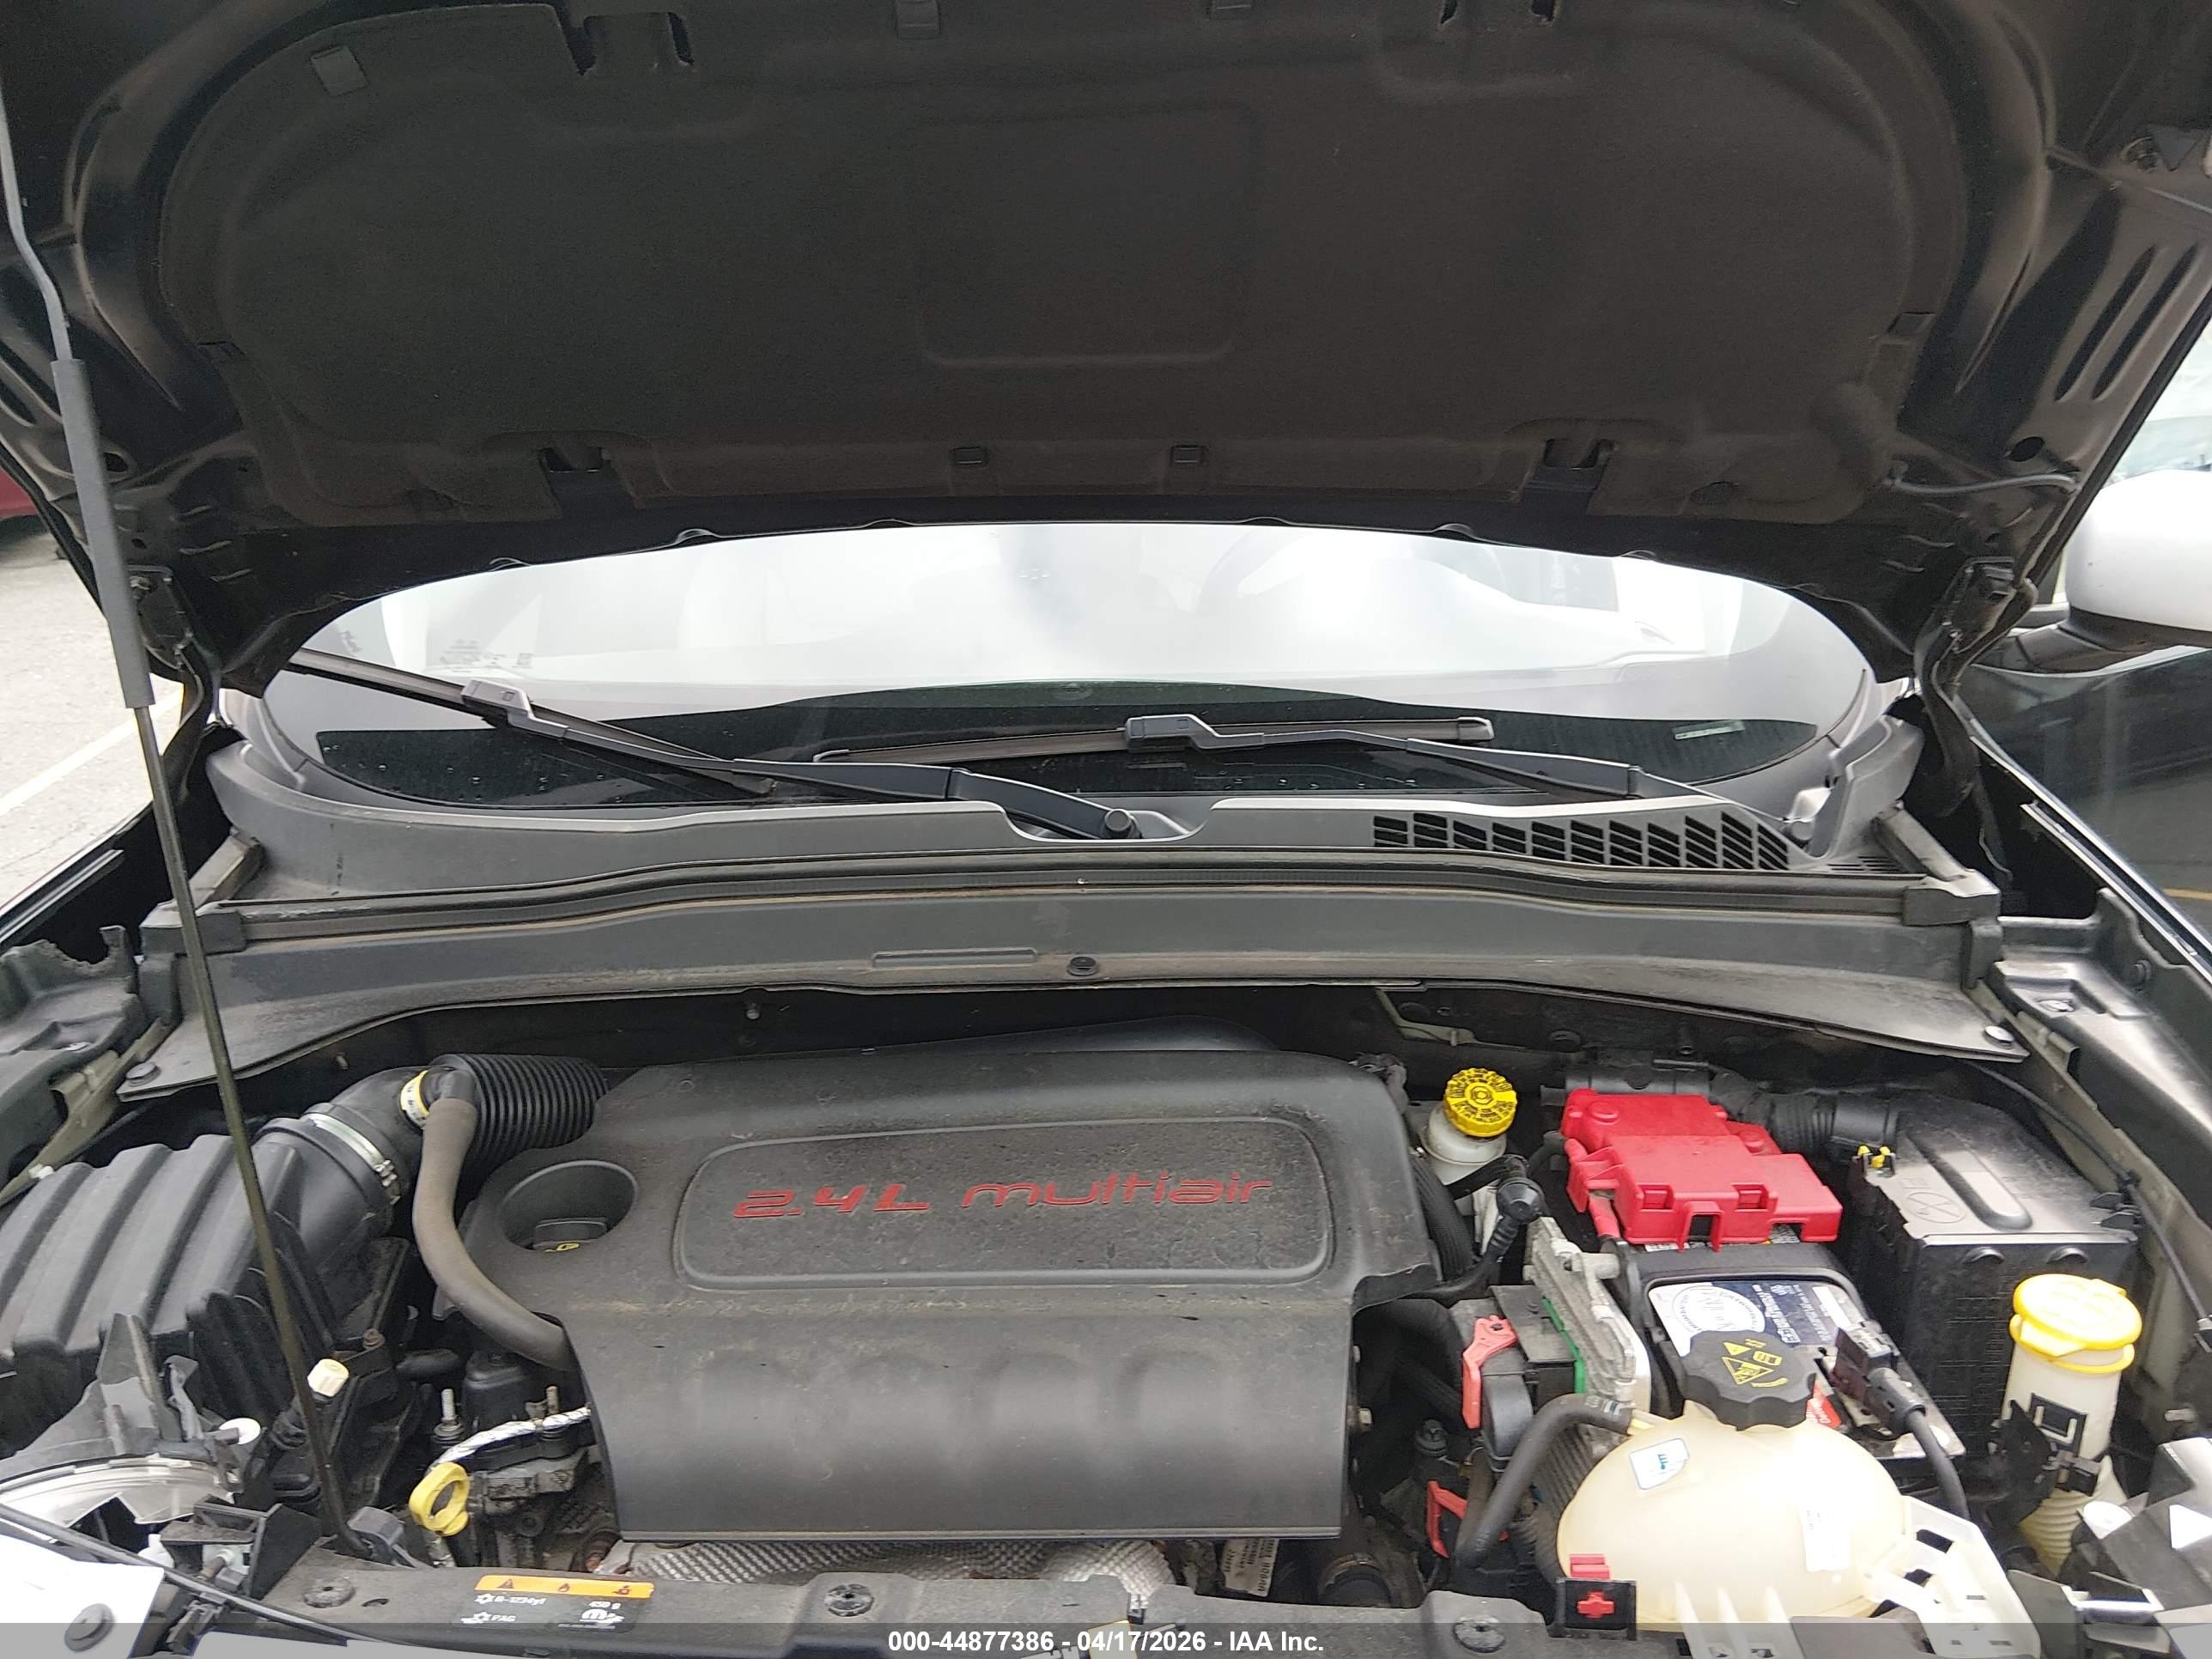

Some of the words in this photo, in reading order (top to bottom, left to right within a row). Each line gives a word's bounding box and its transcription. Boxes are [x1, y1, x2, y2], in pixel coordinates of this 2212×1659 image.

[732, 1183, 931, 1218] 2.4L
[962, 1171, 1273, 1208] multiair
[490, 1613, 517, 1623] PAG
